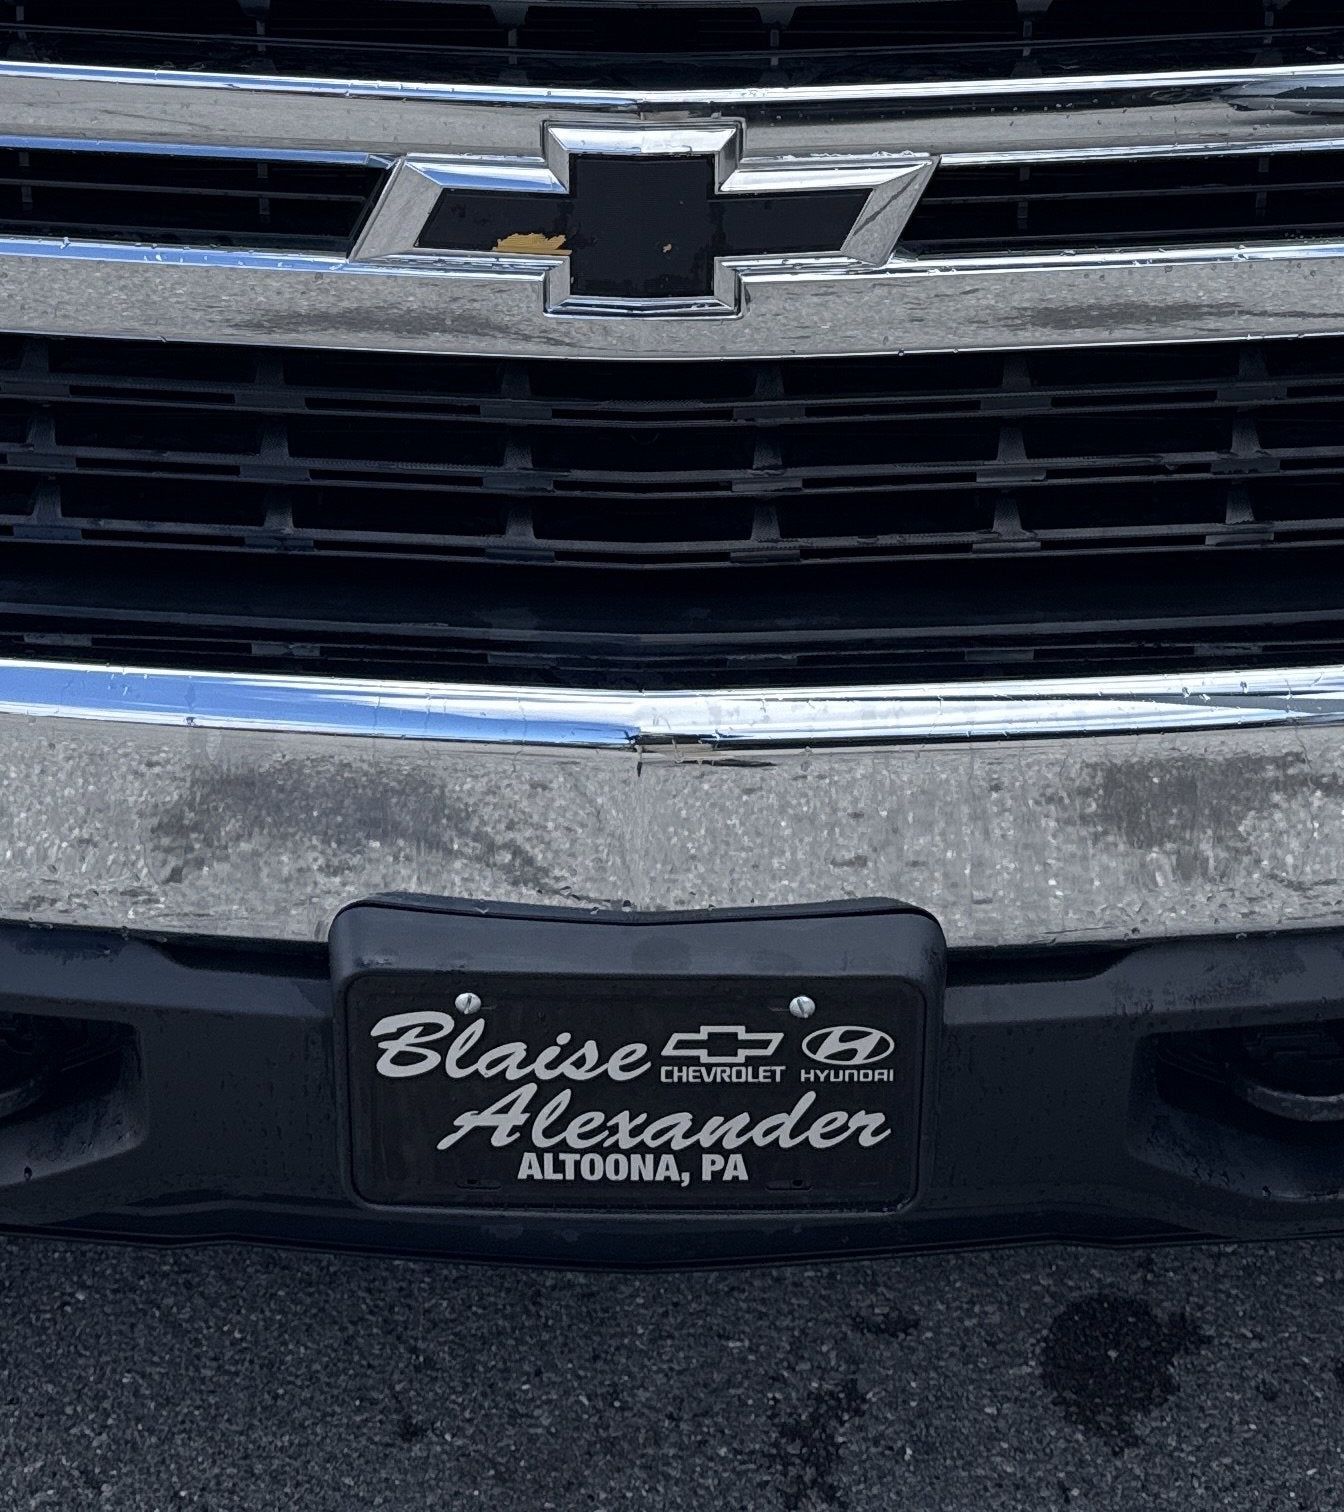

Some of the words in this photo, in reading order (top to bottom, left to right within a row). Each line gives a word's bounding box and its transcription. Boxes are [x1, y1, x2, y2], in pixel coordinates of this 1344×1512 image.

[370, 1011, 652, 1081] Blaise
[660, 1065, 786, 1083] CHEVROLET
[800, 1068, 894, 1083] HYUNDAI
[436, 1082, 892, 1151] Alexander
[517, 1152, 690, 1187] ALTOONA,
[701, 1153, 749, 1182] PA
